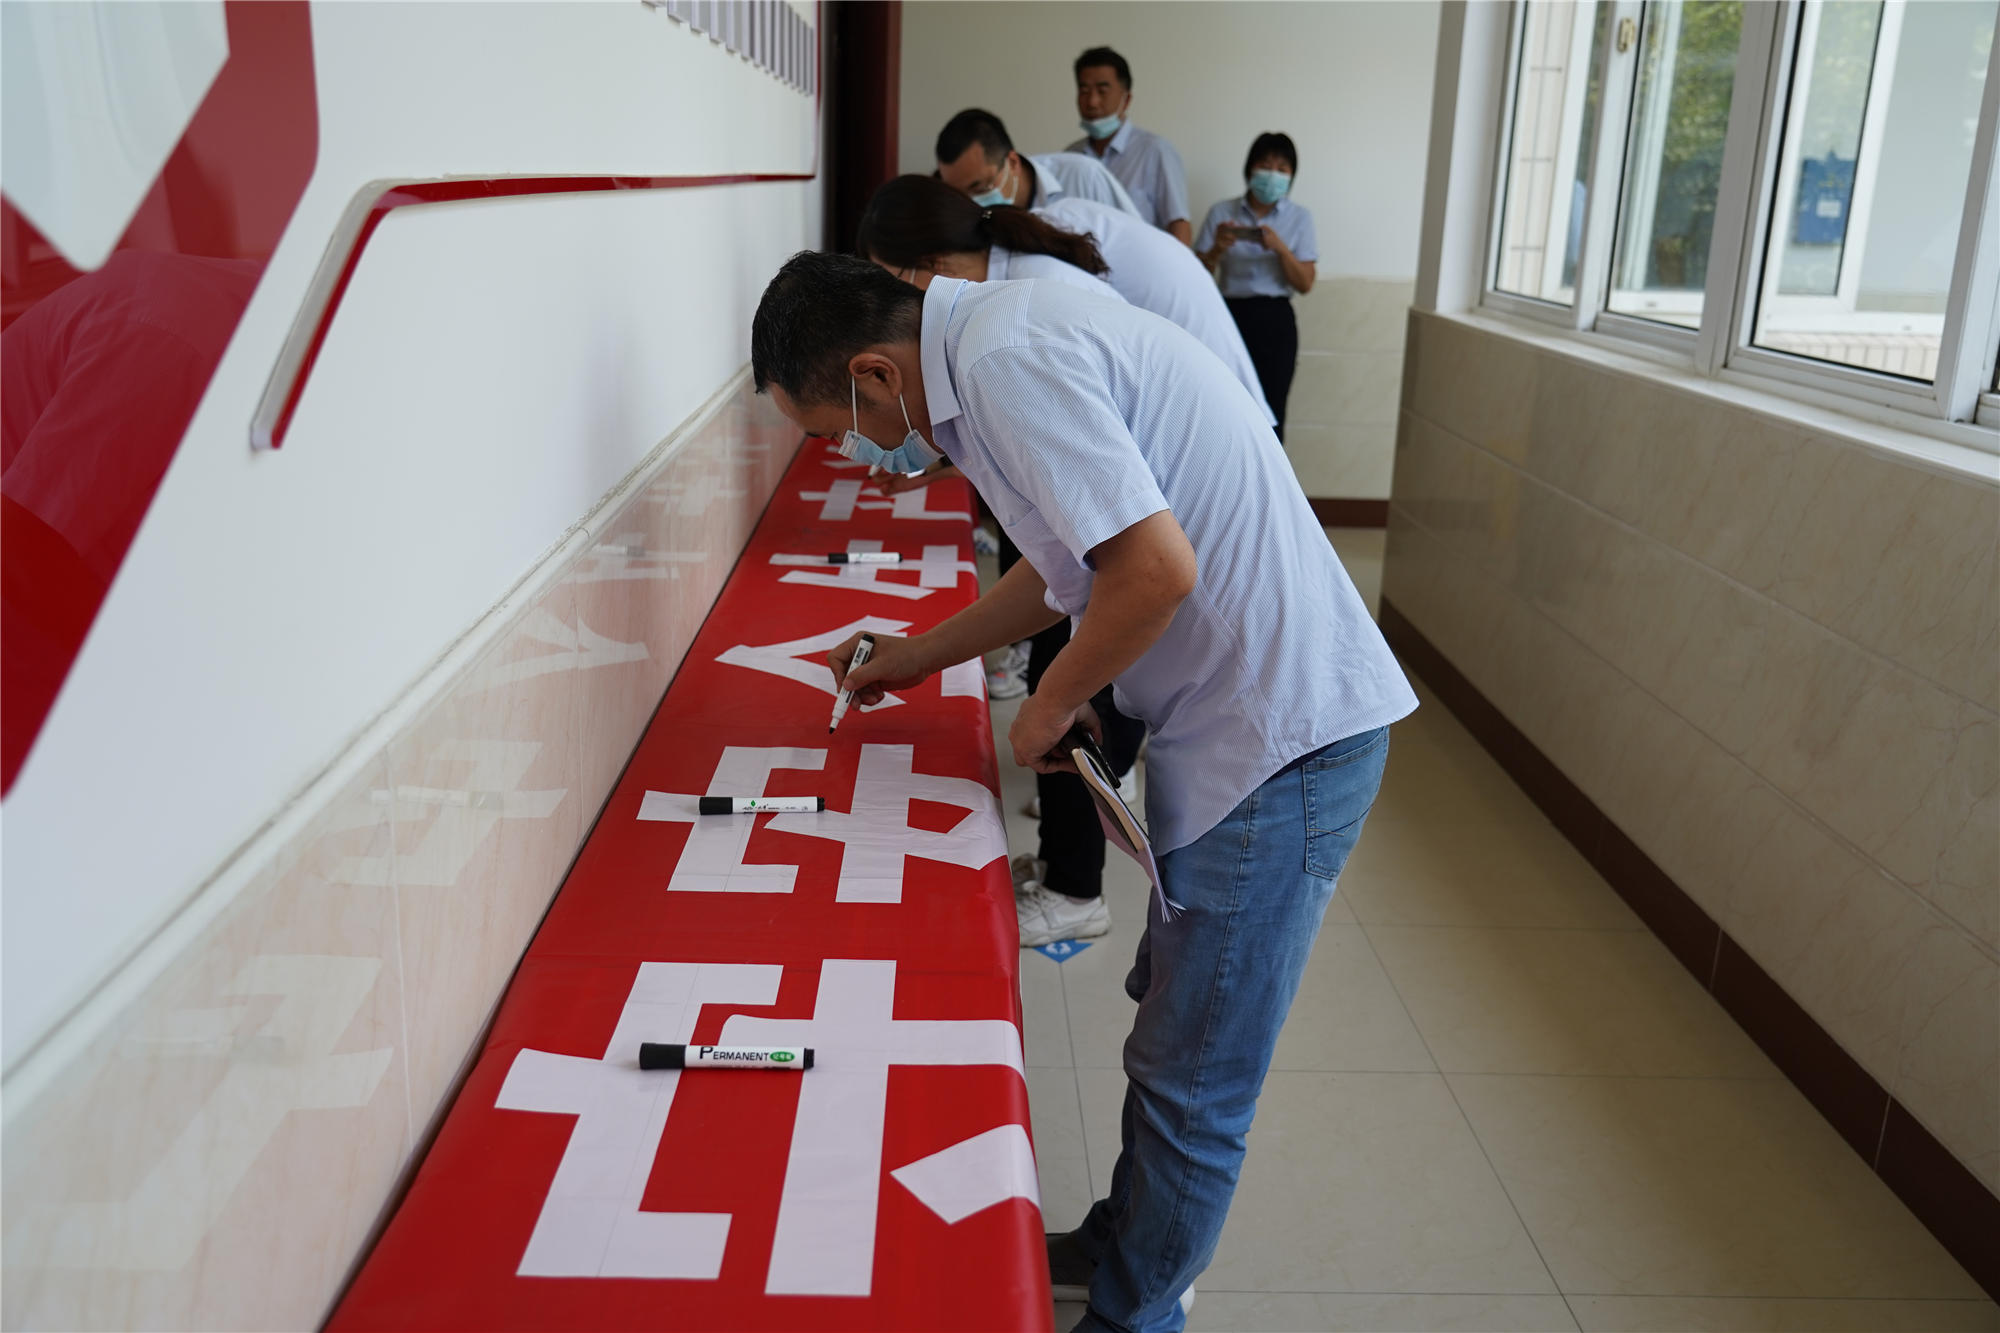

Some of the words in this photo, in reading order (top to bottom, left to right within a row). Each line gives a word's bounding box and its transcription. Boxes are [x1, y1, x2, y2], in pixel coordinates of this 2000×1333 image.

[494, 445, 1040, 1296] 守安全生产
[699, 1046, 770, 1061] PERMANENT
